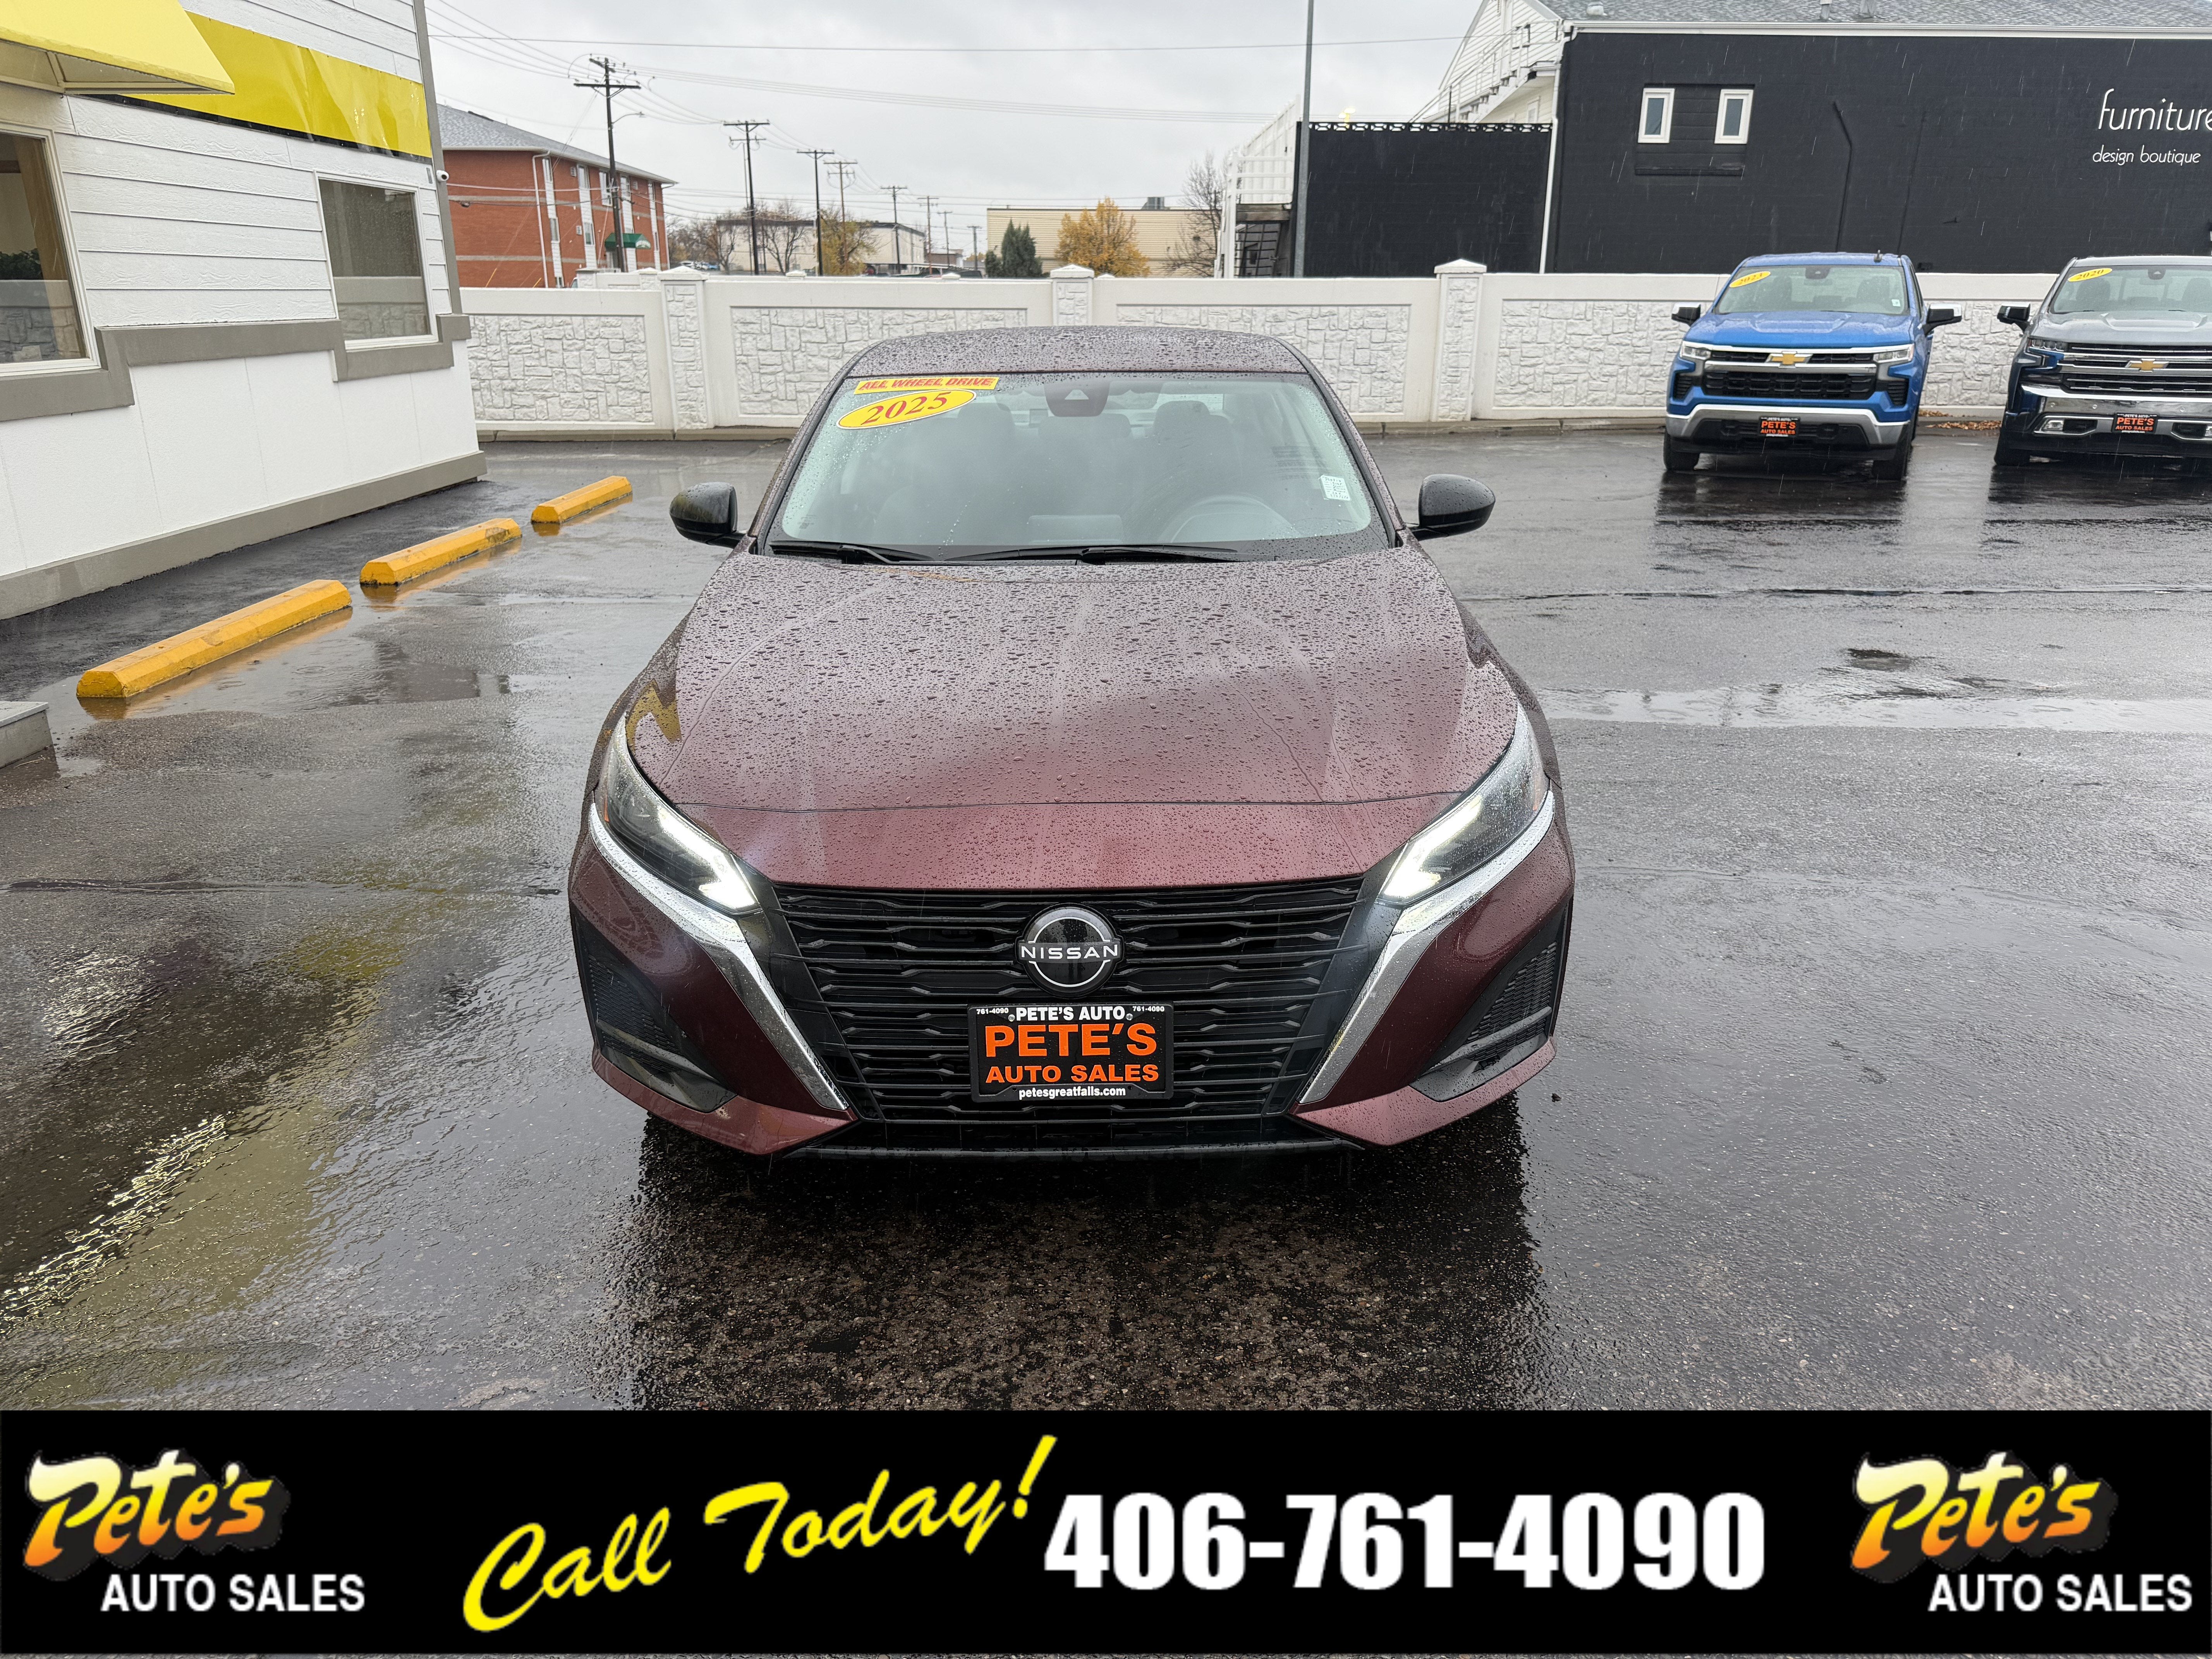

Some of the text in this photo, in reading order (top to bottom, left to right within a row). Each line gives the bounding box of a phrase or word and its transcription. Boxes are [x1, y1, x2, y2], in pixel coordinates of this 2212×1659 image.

[2092, 144, 2201, 166] design boutique
[2076, 269, 2104, 280] 2020
[858, 378, 993, 391] ALL WHEEL DRIVE
[860, 392, 951, 426] 2025
[1761, 421, 1796, 429] PETE'S
[2117, 417, 2154, 426] PETE'S
[1021, 944, 1118, 959] NISSAN
[1016, 1006, 1125, 1021] PETE'S AUTO
[985, 1023, 1157, 1057] PETE'S
[986, 1065, 1159, 1083] AUTO SALES
[1019, 1085, 1126, 1100] petesgreatfalls.com
